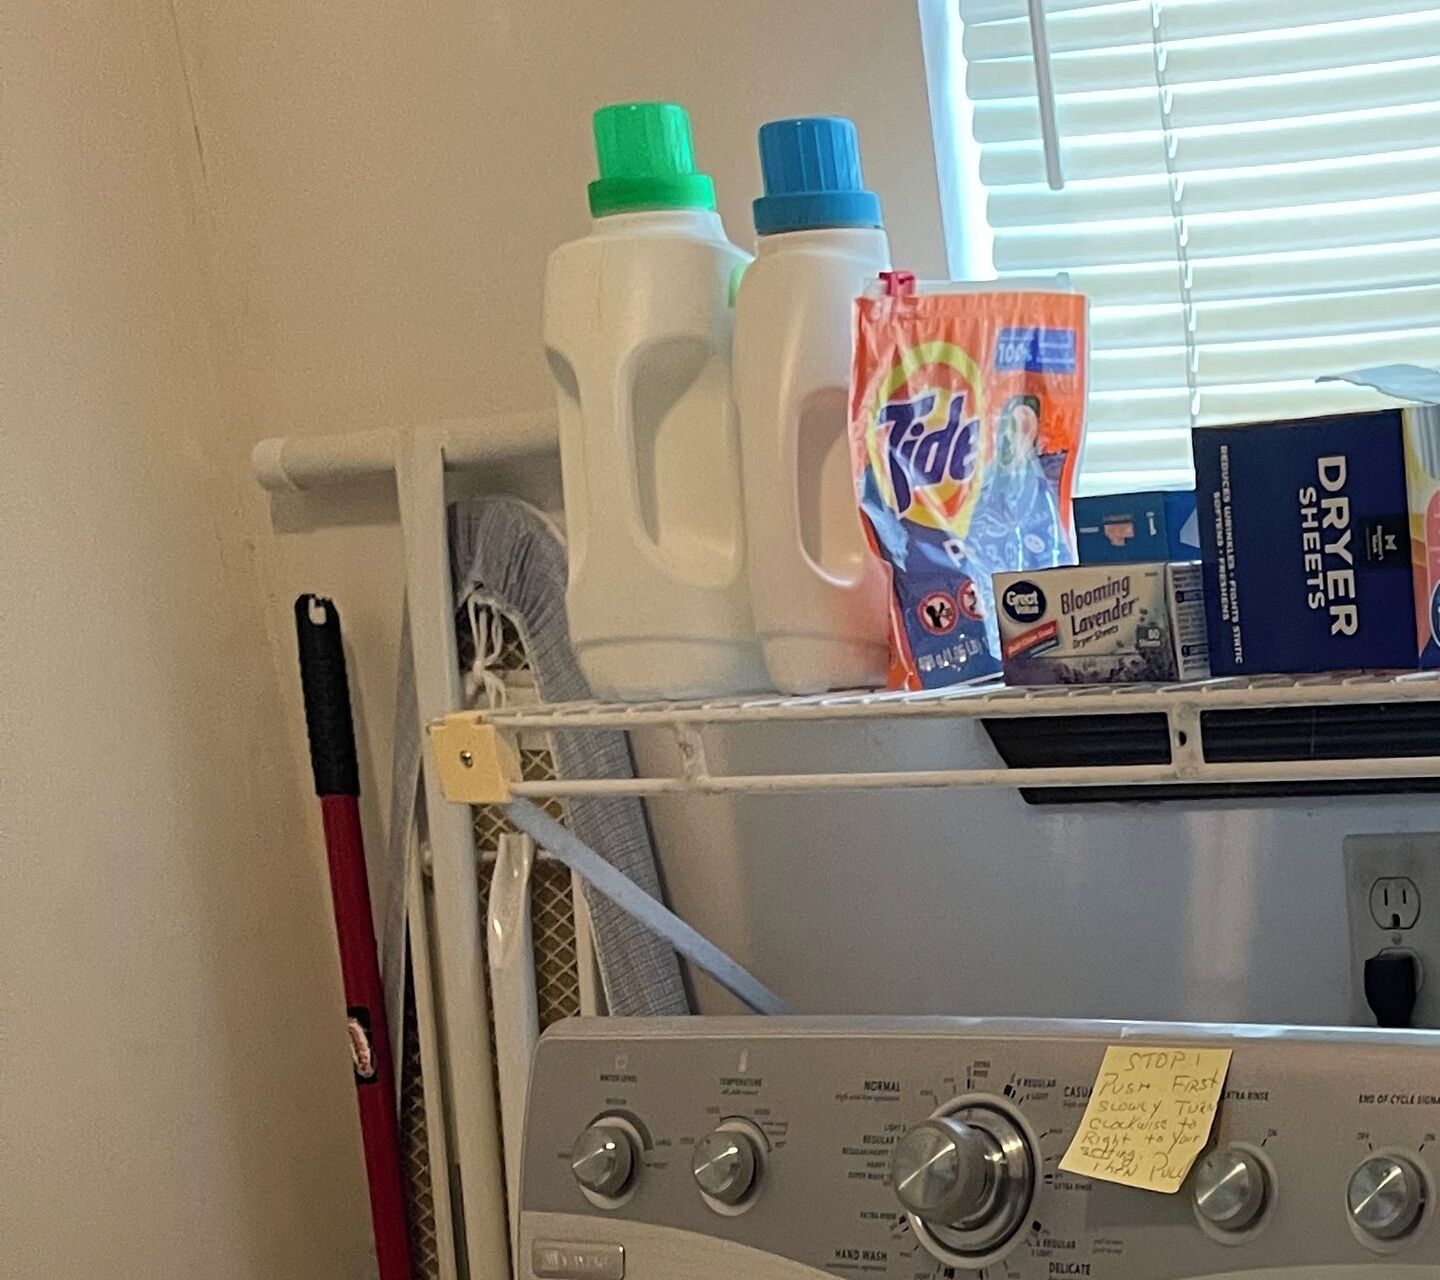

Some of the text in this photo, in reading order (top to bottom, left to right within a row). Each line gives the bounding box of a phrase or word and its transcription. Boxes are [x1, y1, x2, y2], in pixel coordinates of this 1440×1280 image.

[877, 391, 981, 516] Tide
[1220, 445, 1232, 503] REDUCES
[1232, 625, 1244, 665] STATIC
[1299, 486, 1325, 610] SHEETS
[1318, 455, 1358, 637] DRYER
[1060, 576, 1130, 615] Blooming
[1071, 597, 1136, 636] Lavender
[1072, 637, 1094, 650] Dryer
[1144, 1132, 1164, 1144] to
[1179, 1118, 1197, 1130] to
[835, 1250, 860, 1261] HAND
[862, 1251, 888, 1262] WASH
[1049, 1262, 1091, 1275] DELICATE
